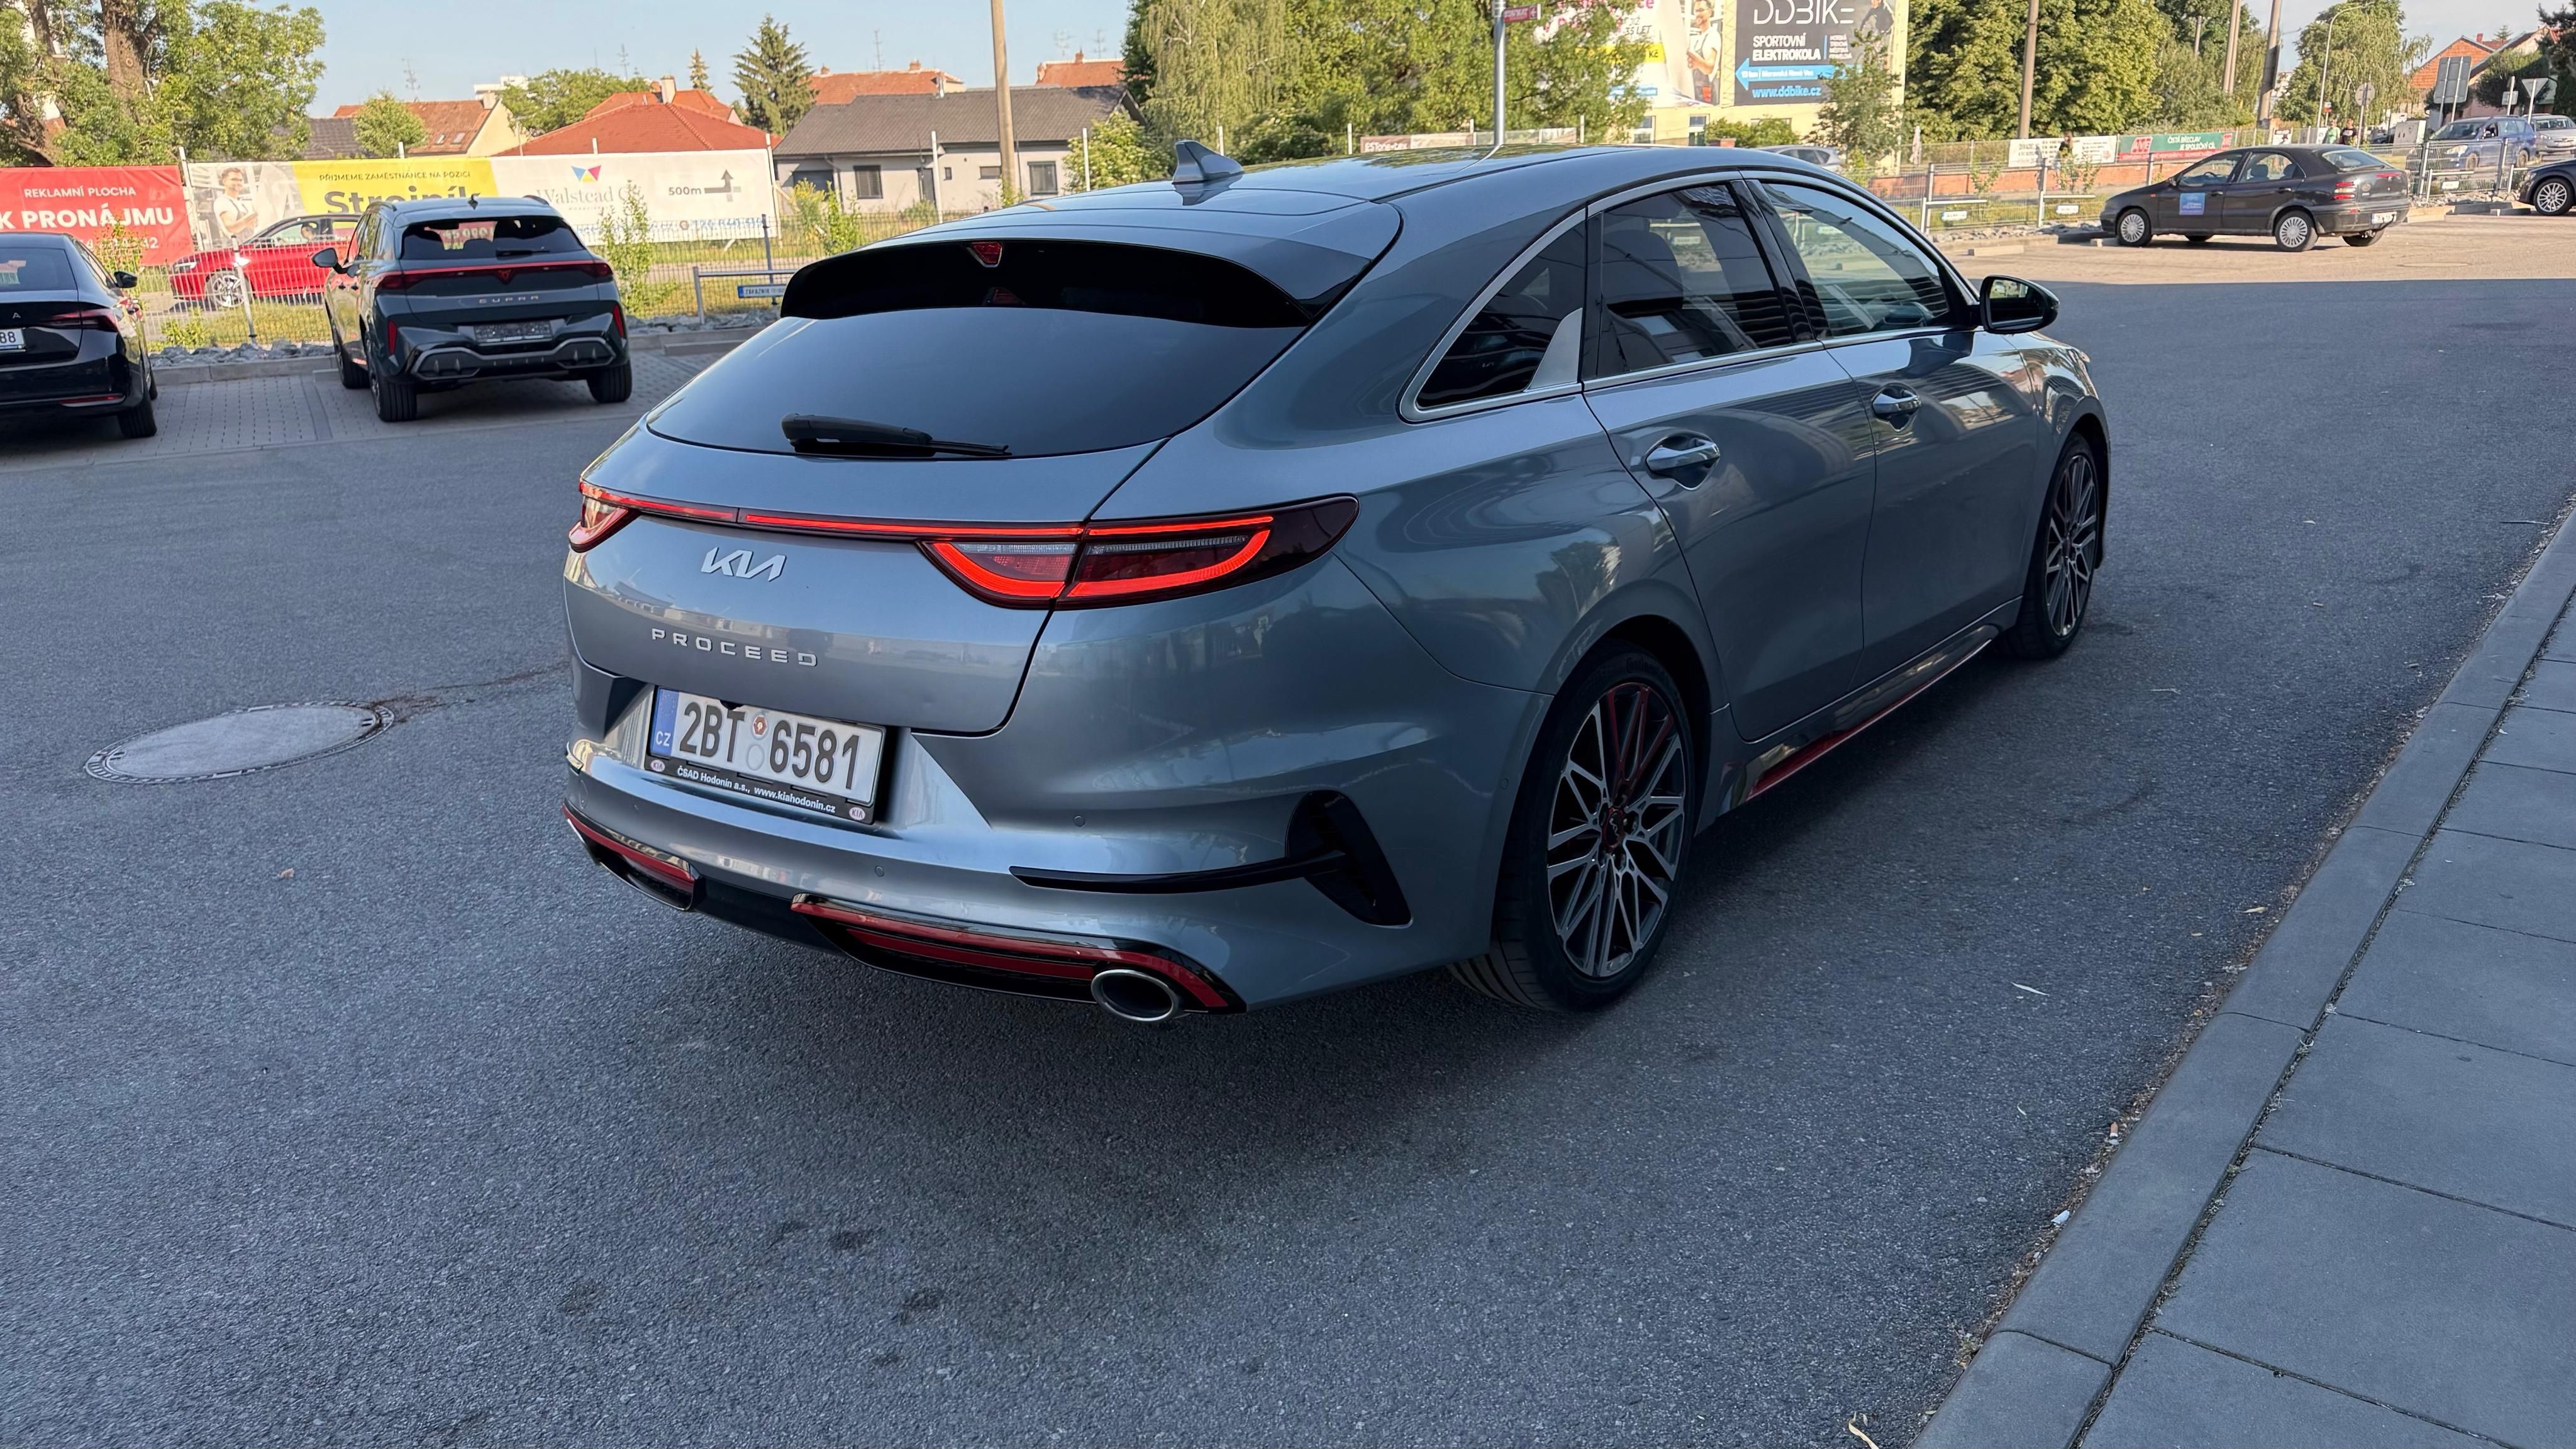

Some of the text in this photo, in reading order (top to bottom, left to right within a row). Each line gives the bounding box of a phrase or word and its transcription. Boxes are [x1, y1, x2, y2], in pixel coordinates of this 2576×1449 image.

[1753, 33, 1806, 47] SPORTOVNÍ
[1752, 48, 1821, 61] ELEKTROKOLA
[1752, 86, 1822, 98] www.ddbike.cz
[24, 186, 136, 198] REKLAMNÍ PLOCHA
[669, 187, 702, 196] 500m
[0, 203, 174, 230] K PRONÁJMU
[701, 546, 787, 582] KIA
[652, 628, 818, 667] PROCEED
[655, 730, 672, 748] CZ
[679, 701, 860, 790] 2BT 6581
[652, 761, 663, 771] KIA
[677, 765, 836, 813] ČSAD Hodonín a.s., www.kiahodonin.cz
[851, 809, 864, 819] KIA
